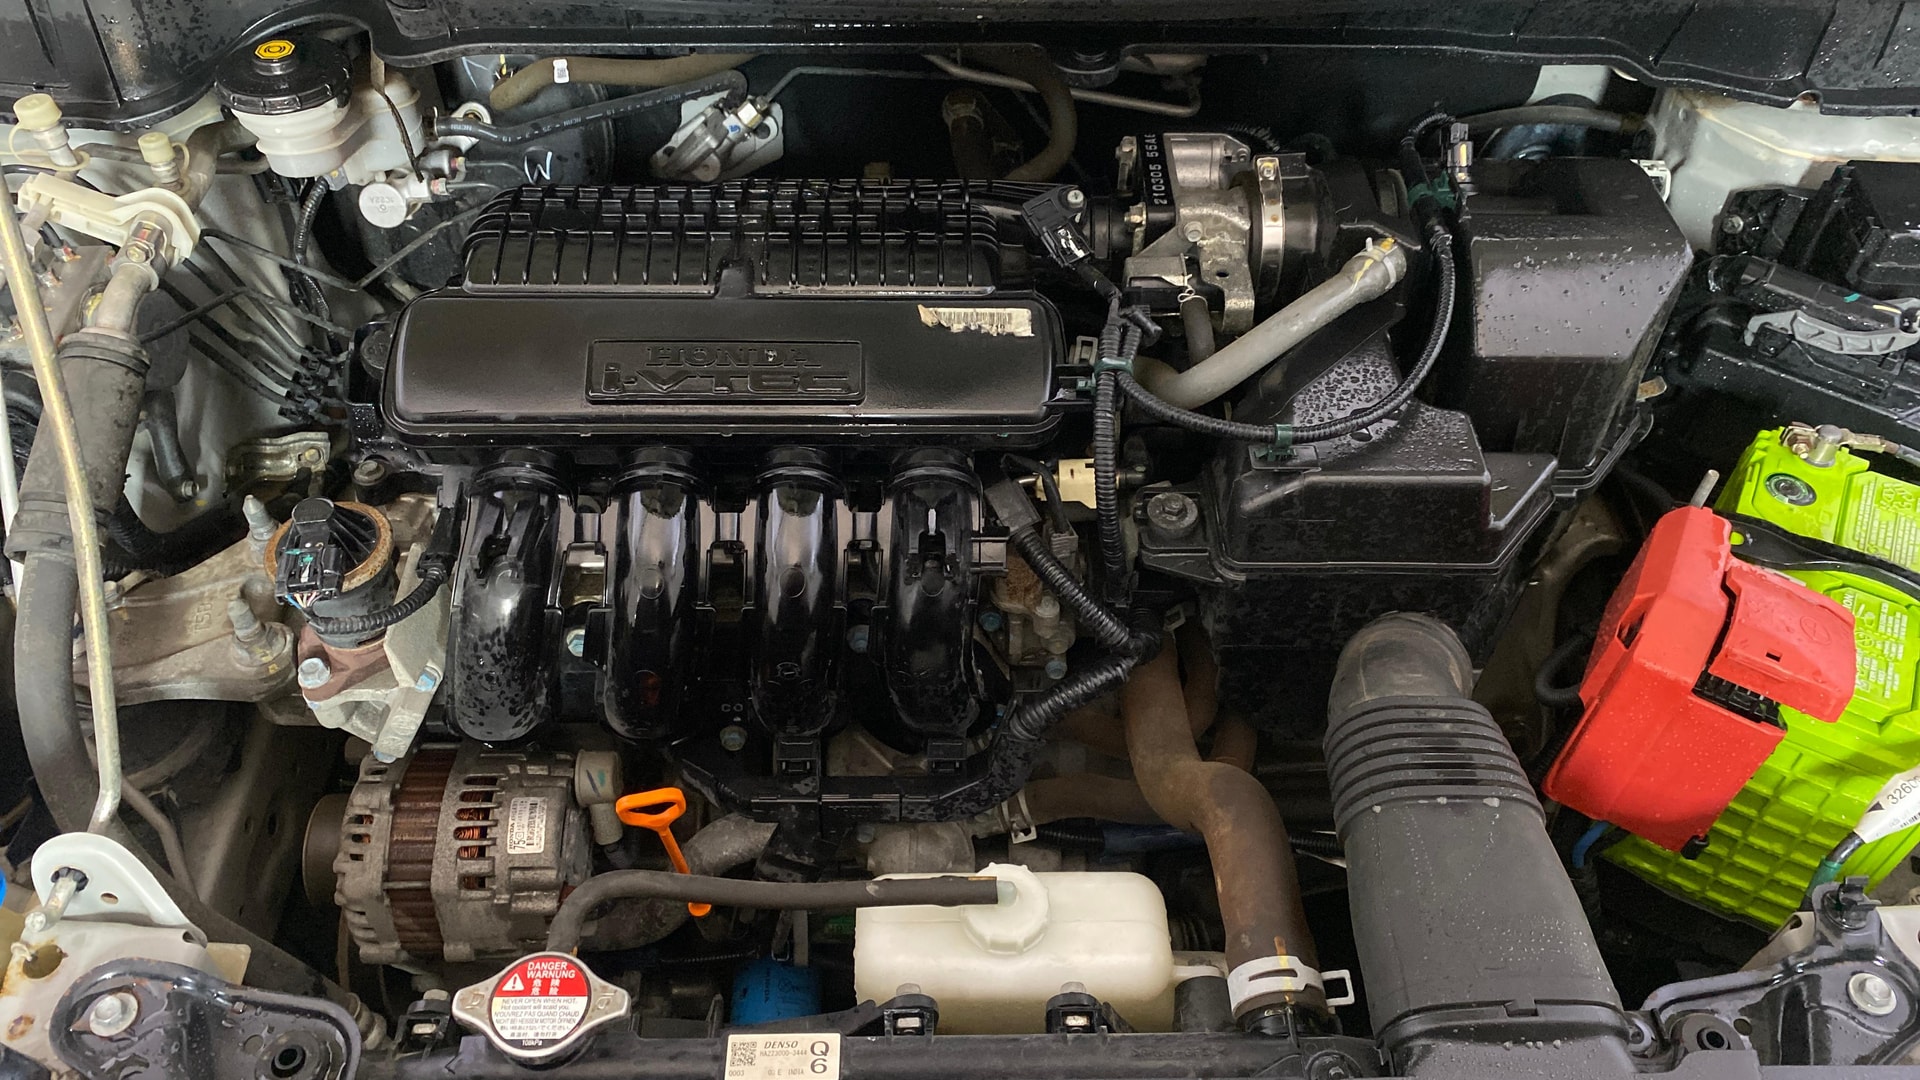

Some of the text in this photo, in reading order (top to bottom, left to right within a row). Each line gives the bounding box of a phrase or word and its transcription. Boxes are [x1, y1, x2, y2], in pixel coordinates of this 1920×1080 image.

[1149, 163, 1168, 205] 210305
[645, 347, 822, 368] HONDA
[508, 822, 516, 850] HONDA
[513, 840, 526, 851] 75
[527, 961, 568, 970] DANGER
[526, 970, 576, 979] WARNUNG
[764, 1041, 799, 1049] DENSO
[810, 1041, 830, 1057] Q
[810, 1057, 828, 1074] 6
